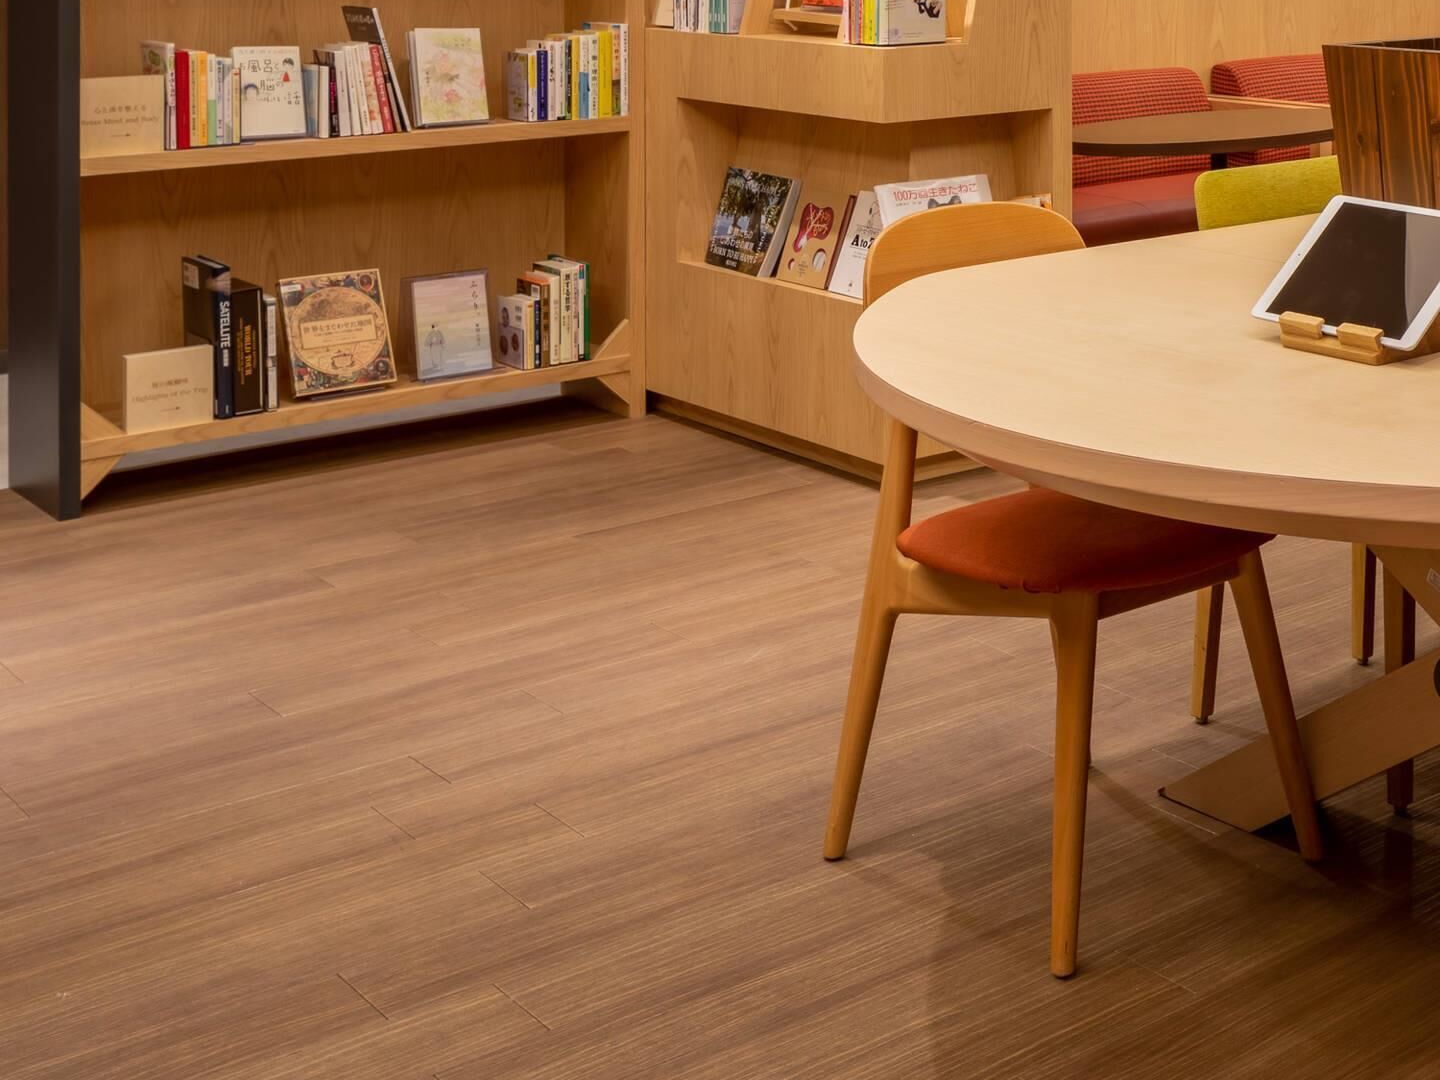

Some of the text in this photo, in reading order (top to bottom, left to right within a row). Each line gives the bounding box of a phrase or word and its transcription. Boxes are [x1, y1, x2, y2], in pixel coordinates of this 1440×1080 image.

[850, 233, 860, 247] A
[860, 238, 869, 249] to
[219, 300, 231, 350] SATELLITE
